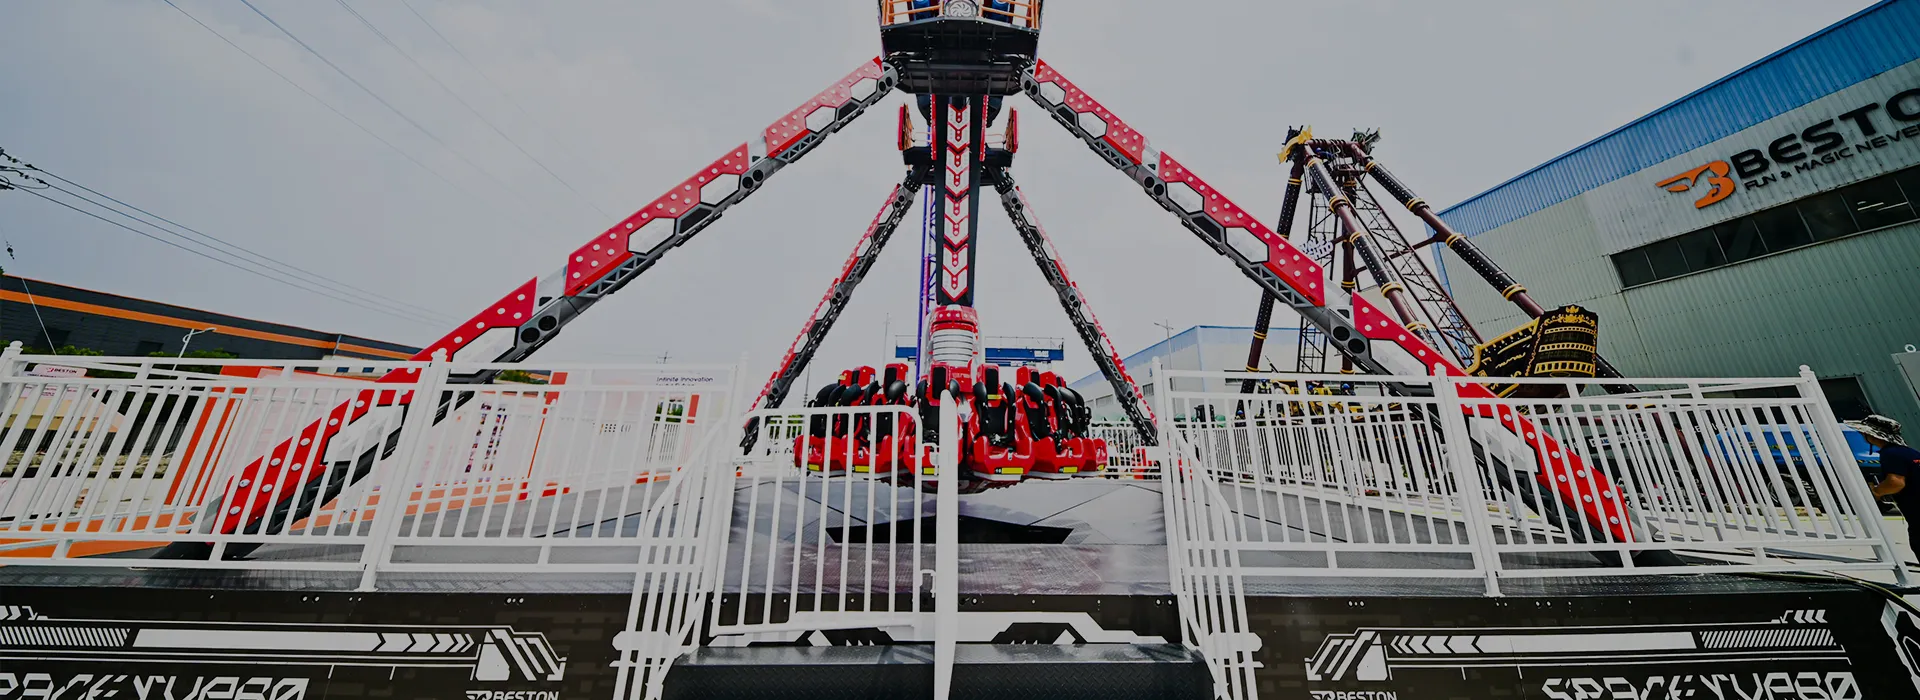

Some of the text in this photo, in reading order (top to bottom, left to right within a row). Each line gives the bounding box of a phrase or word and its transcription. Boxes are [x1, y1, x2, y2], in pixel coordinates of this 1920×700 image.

[1744, 124, 1920, 190] FUN & MAGIC NEVE
